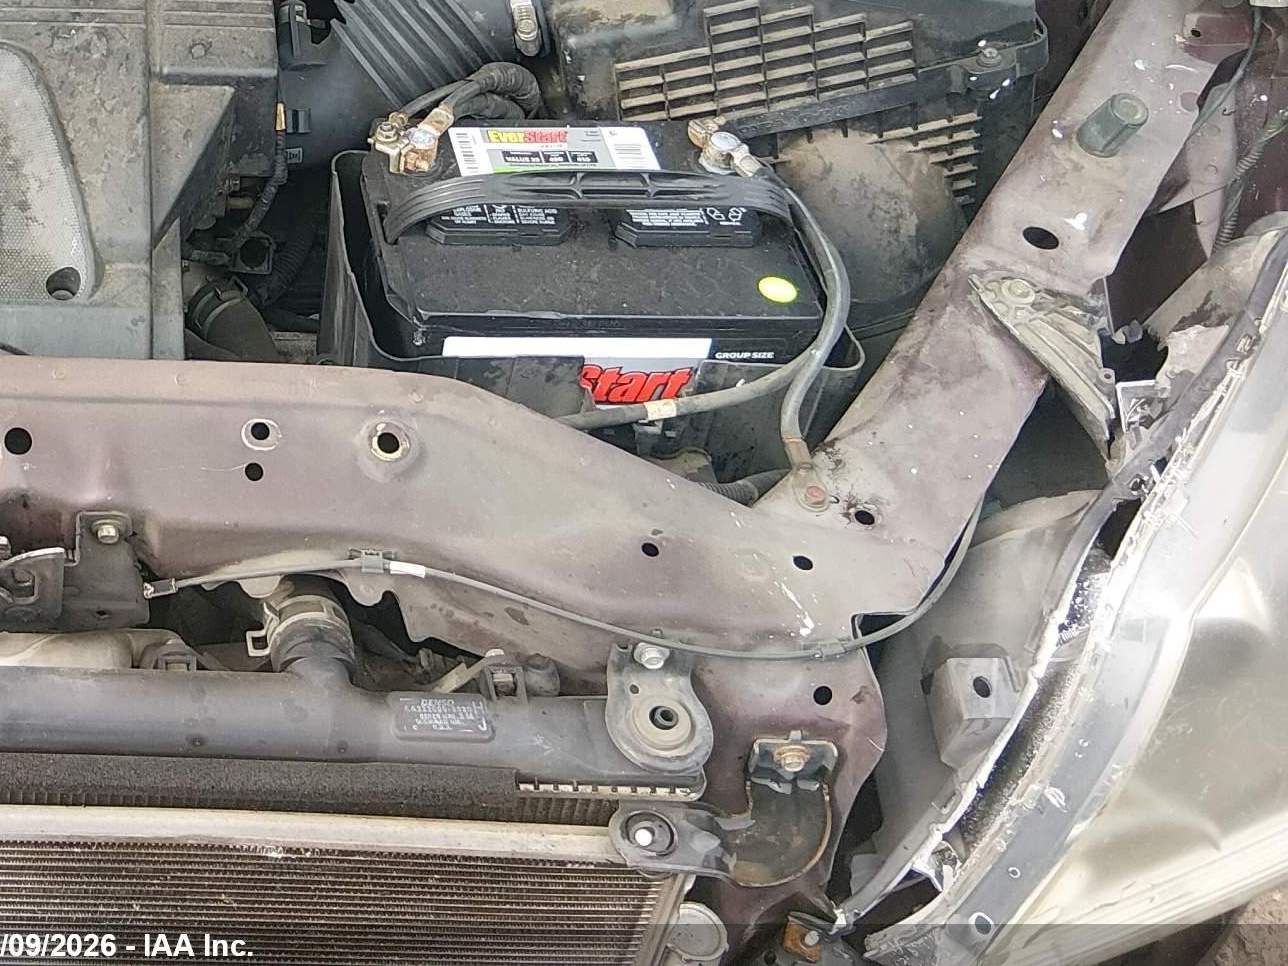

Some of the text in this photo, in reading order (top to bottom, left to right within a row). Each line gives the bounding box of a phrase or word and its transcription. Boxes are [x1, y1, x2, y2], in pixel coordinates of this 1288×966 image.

[488, 130, 568, 144] EverStart
[715, 351, 775, 360] GROUP SIZE
